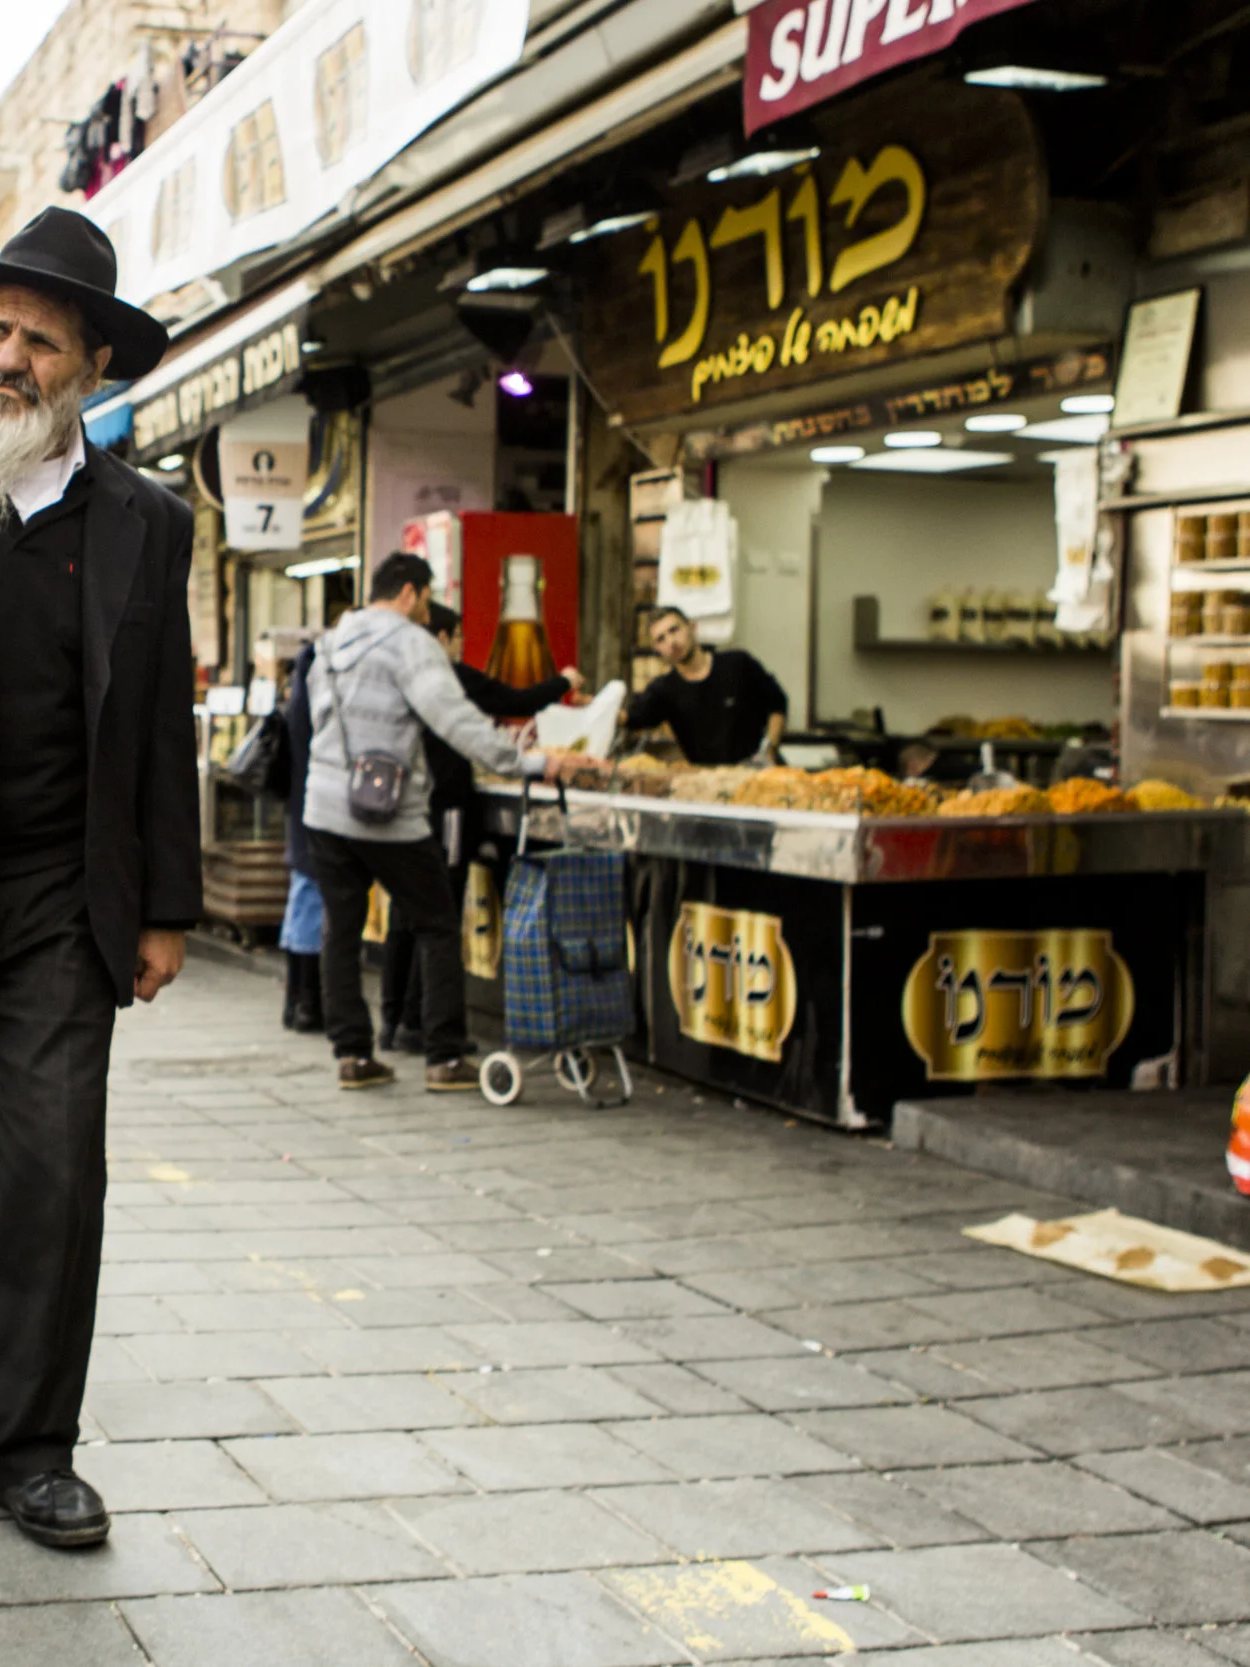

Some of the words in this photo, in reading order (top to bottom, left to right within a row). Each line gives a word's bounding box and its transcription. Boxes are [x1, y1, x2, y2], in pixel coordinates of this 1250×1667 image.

[780, 307, 811, 367] של
[257, 504, 275, 532] 7
[936, 953, 1104, 1046] מורנו
